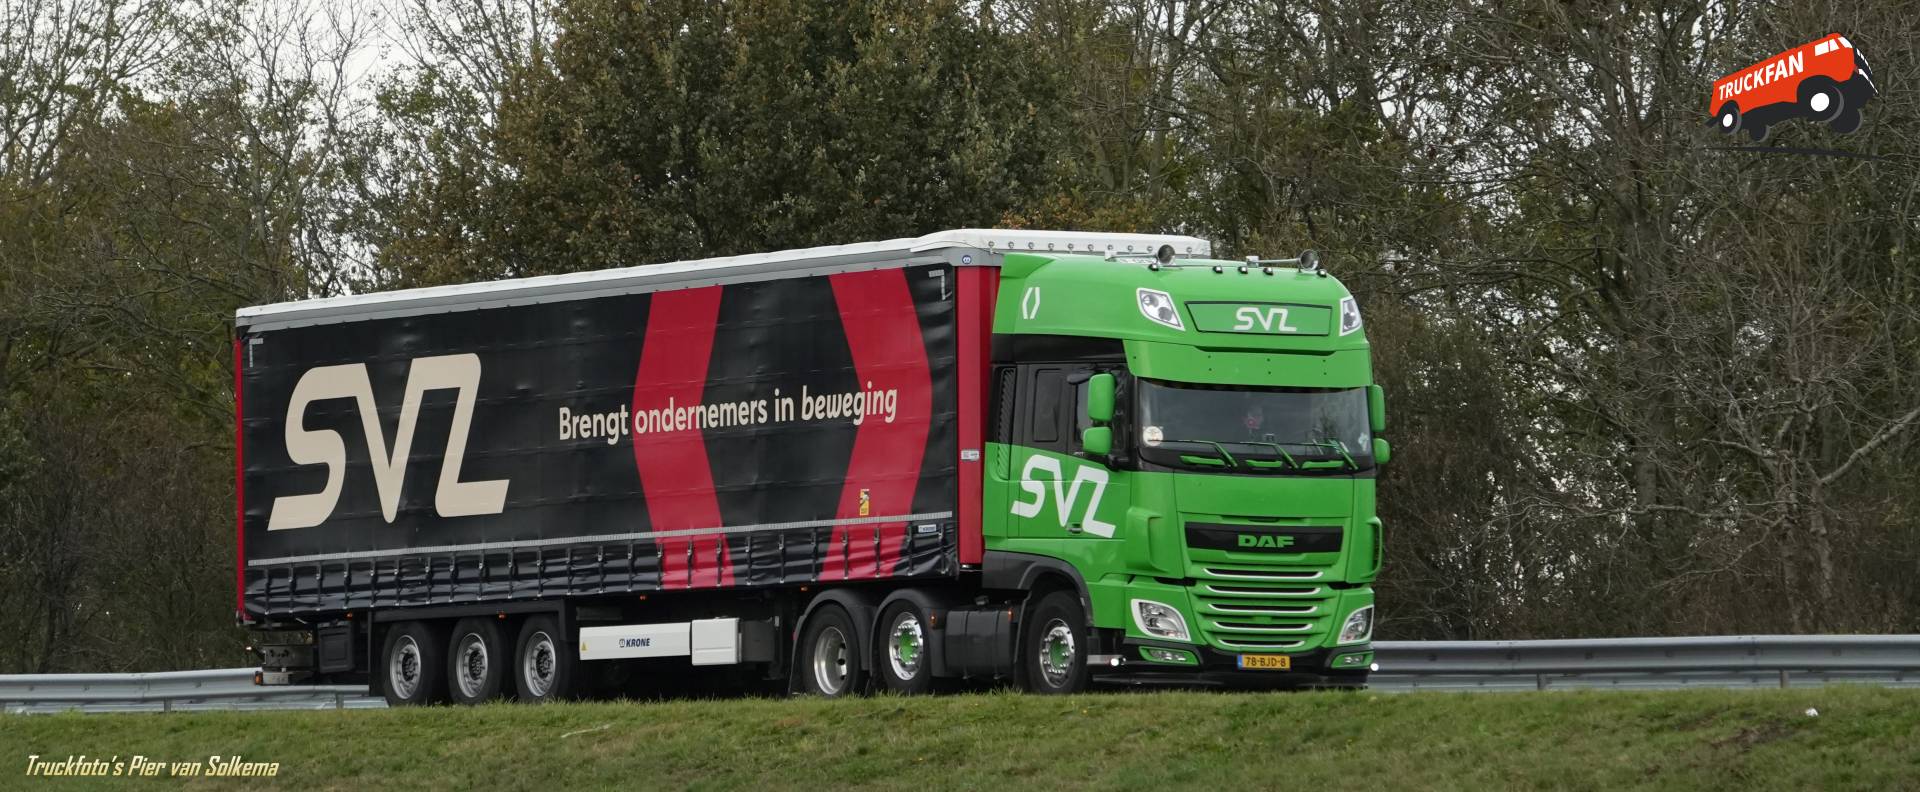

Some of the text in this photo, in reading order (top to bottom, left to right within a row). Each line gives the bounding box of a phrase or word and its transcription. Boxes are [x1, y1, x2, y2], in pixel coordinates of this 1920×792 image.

[559, 381, 898, 445] Brengt ondernemers in beweging
[1238, 535, 1294, 547] DAF
[626, 637, 651, 648] KRONE
[1246, 657, 1286, 667] 78-BJD-8
